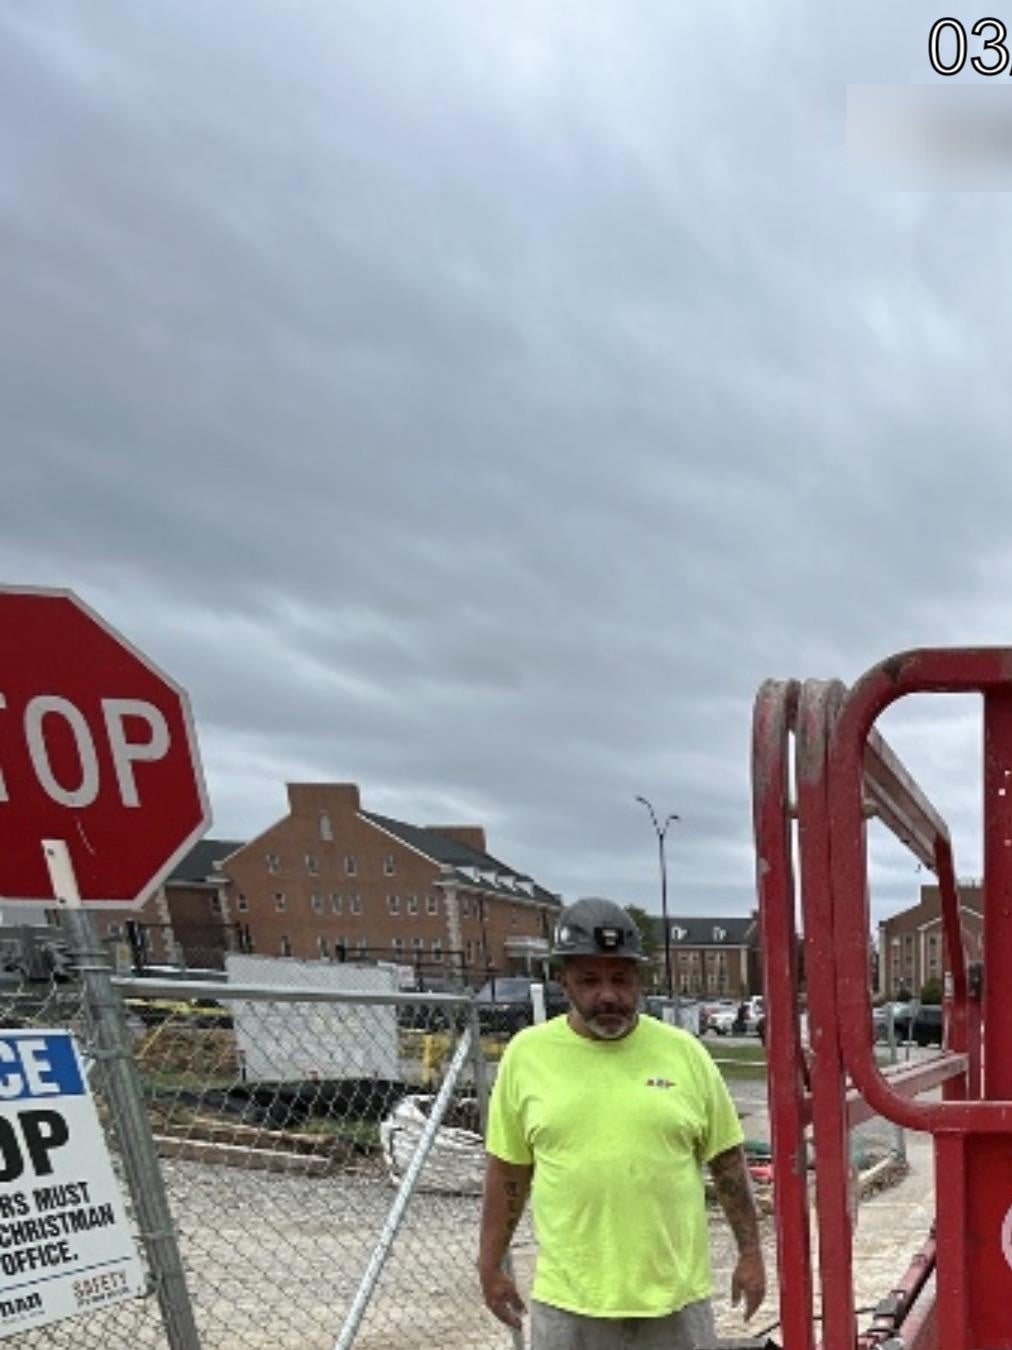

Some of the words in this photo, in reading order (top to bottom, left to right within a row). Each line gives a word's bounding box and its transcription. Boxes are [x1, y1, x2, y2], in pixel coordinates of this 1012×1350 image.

[0, 692, 172, 808] OP
[32, 1181, 90, 1212] MUST
[0, 1202, 115, 1248] CHRISTMAN
[1, 1240, 79, 1276] OFFICE.
